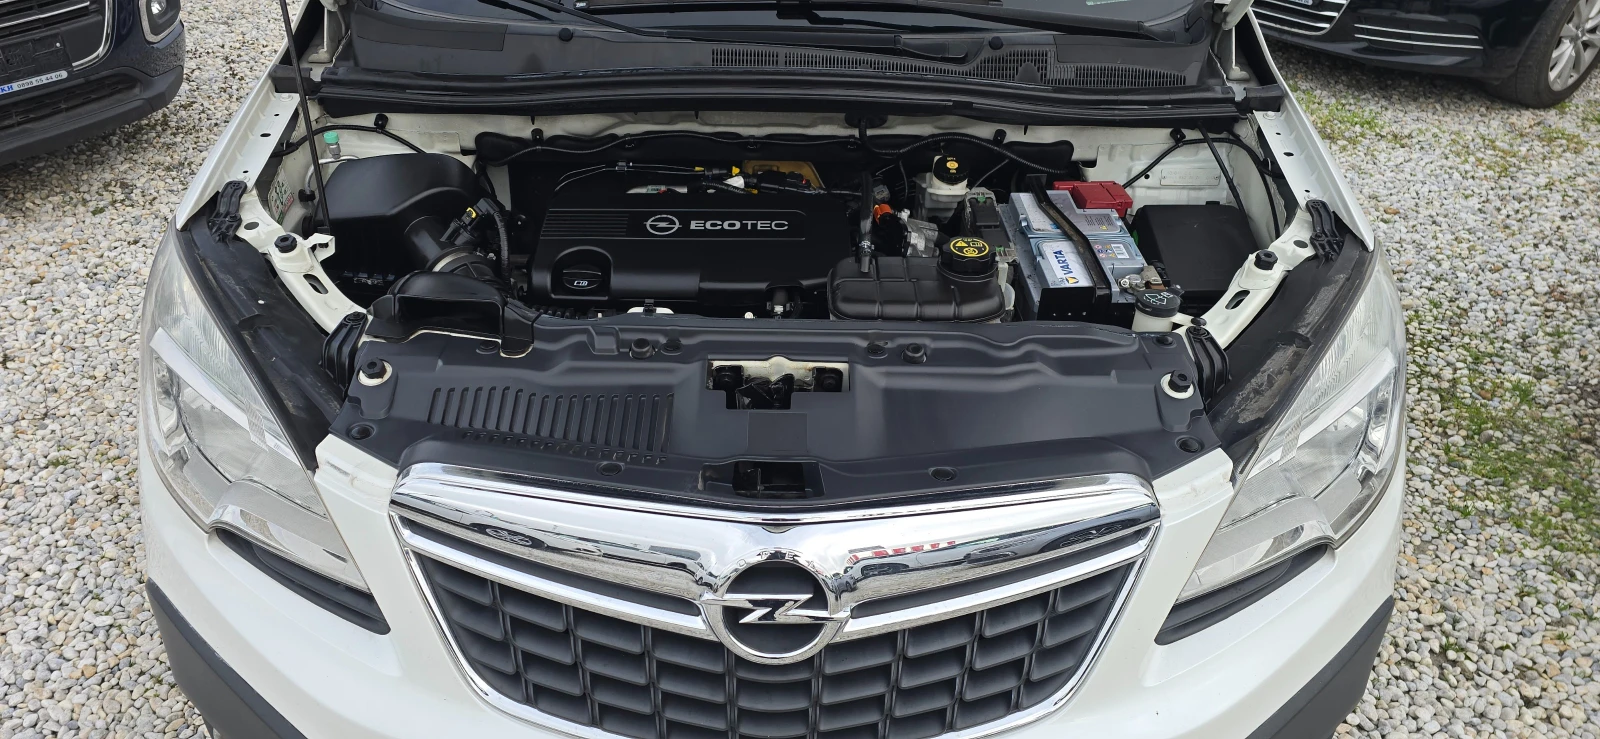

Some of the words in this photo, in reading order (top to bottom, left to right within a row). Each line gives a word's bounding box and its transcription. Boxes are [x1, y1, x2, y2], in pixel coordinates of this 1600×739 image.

[17, 80, 34, 88] 0898
[689, 220, 789, 231] ECOTEC
[1052, 249, 1074, 276] VARTA
